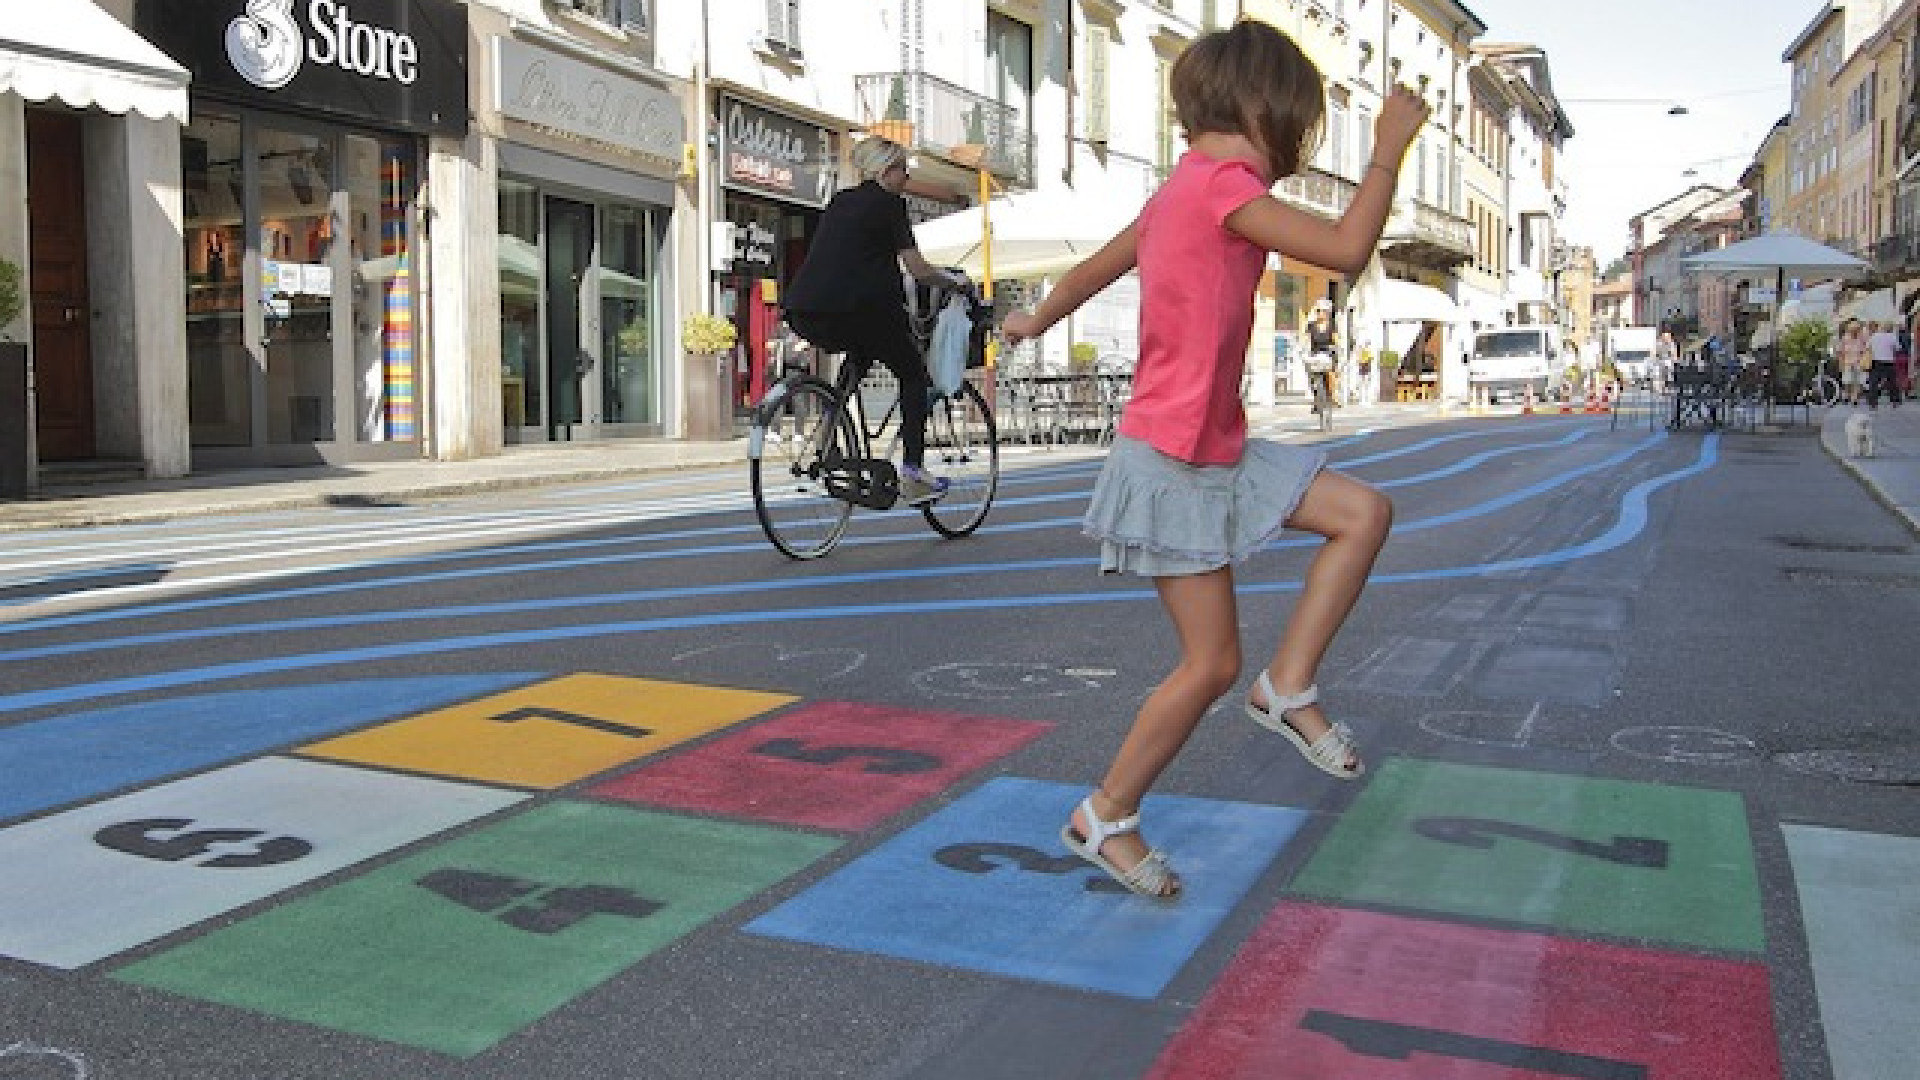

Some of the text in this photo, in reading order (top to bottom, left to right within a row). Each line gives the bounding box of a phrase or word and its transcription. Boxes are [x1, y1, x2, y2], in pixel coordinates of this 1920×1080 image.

[308, 0, 418, 84] Store
[485, 707, 655, 739] 7
[748, 738, 943, 775] 5
[1411, 814, 1670, 869] 2
[416, 867, 669, 935] 4
[1297, 1008, 1648, 1080] 1
